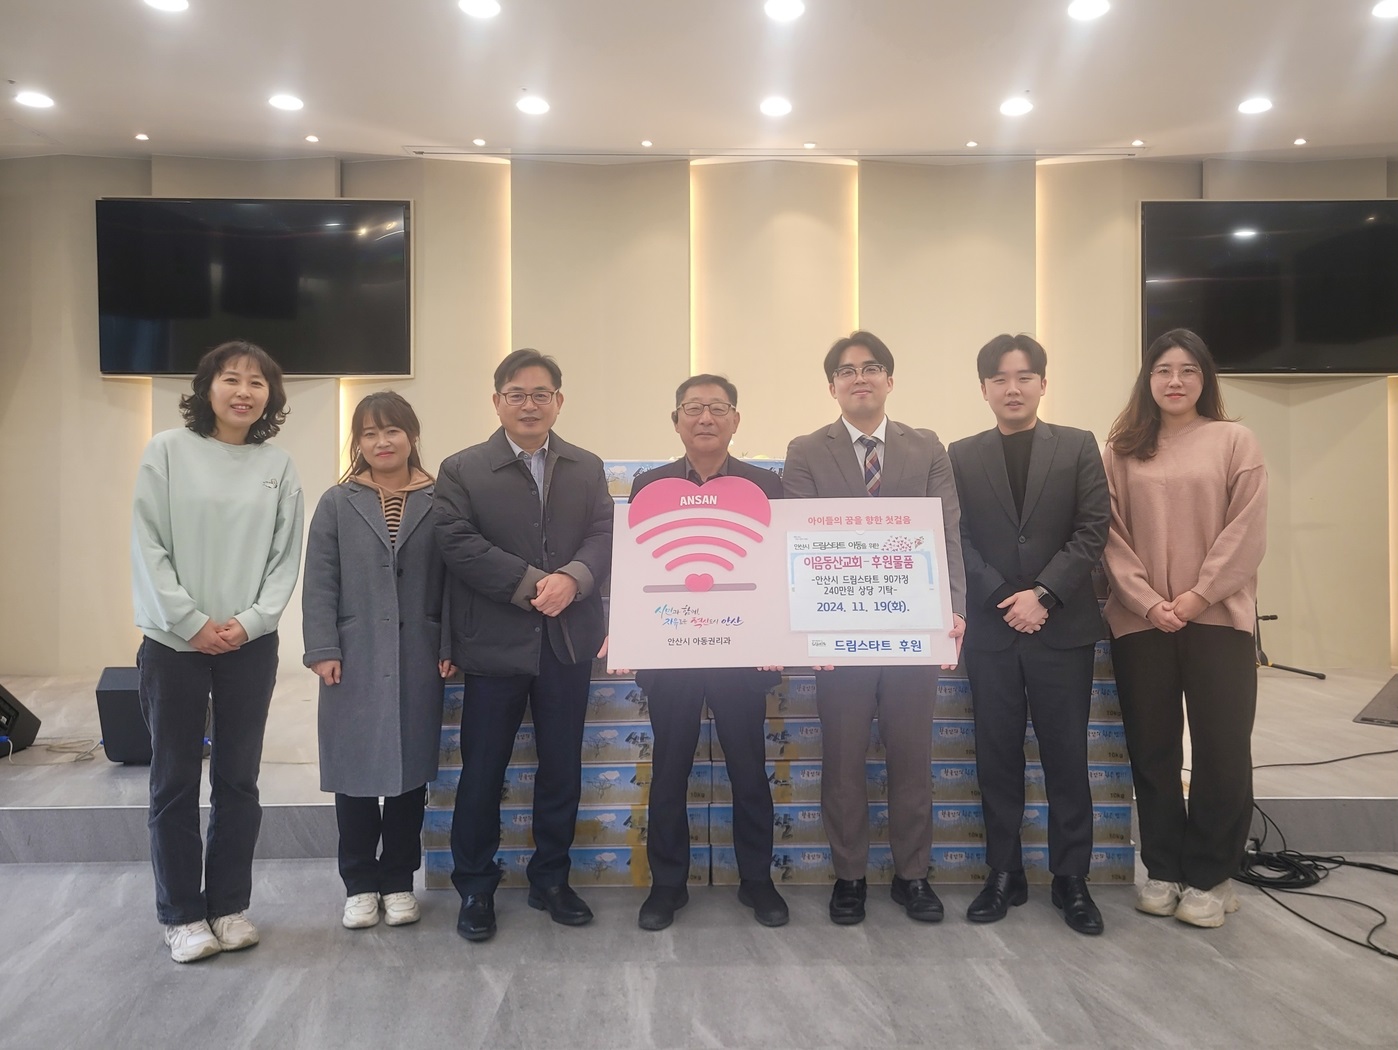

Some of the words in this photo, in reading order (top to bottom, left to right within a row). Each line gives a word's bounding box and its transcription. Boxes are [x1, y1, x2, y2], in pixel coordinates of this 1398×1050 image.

[680, 495, 718, 506] ANSAN
[808, 516, 842, 526] 아이들의
[845, 516, 862, 525] 꿈을
[865, 516, 882, 525] 향한
[885, 515, 911, 525] 첫걸음
[794, 543, 810, 551] 안산시
[812, 542, 846, 551] 드림스타트
[848, 542, 866, 550] 아동을
[812, 575, 839, 585] -안산시
[842, 575, 880, 584] 드림스타트
[883, 575, 909, 584] 90가정
[824, 586, 855, 596] 240만원
[858, 585, 874, 595] 상당
[878, 585, 898, 595] 기탁-
[655, 604, 680, 618] 시민과
[817, 602, 846, 613] 2024.
[852, 602, 868, 613] 11.
[874, 600, 910, 613] 19(화).
[663, 618, 688, 629] 자유로운
[690, 617, 719, 628] 혁신도시
[721, 616, 744, 627] 안산
[668, 637, 690, 646] 안산시
[693, 637, 731, 646] 아동권리과
[835, 640, 892, 652] 드림스타트
[899, 640, 922, 652] 후원
